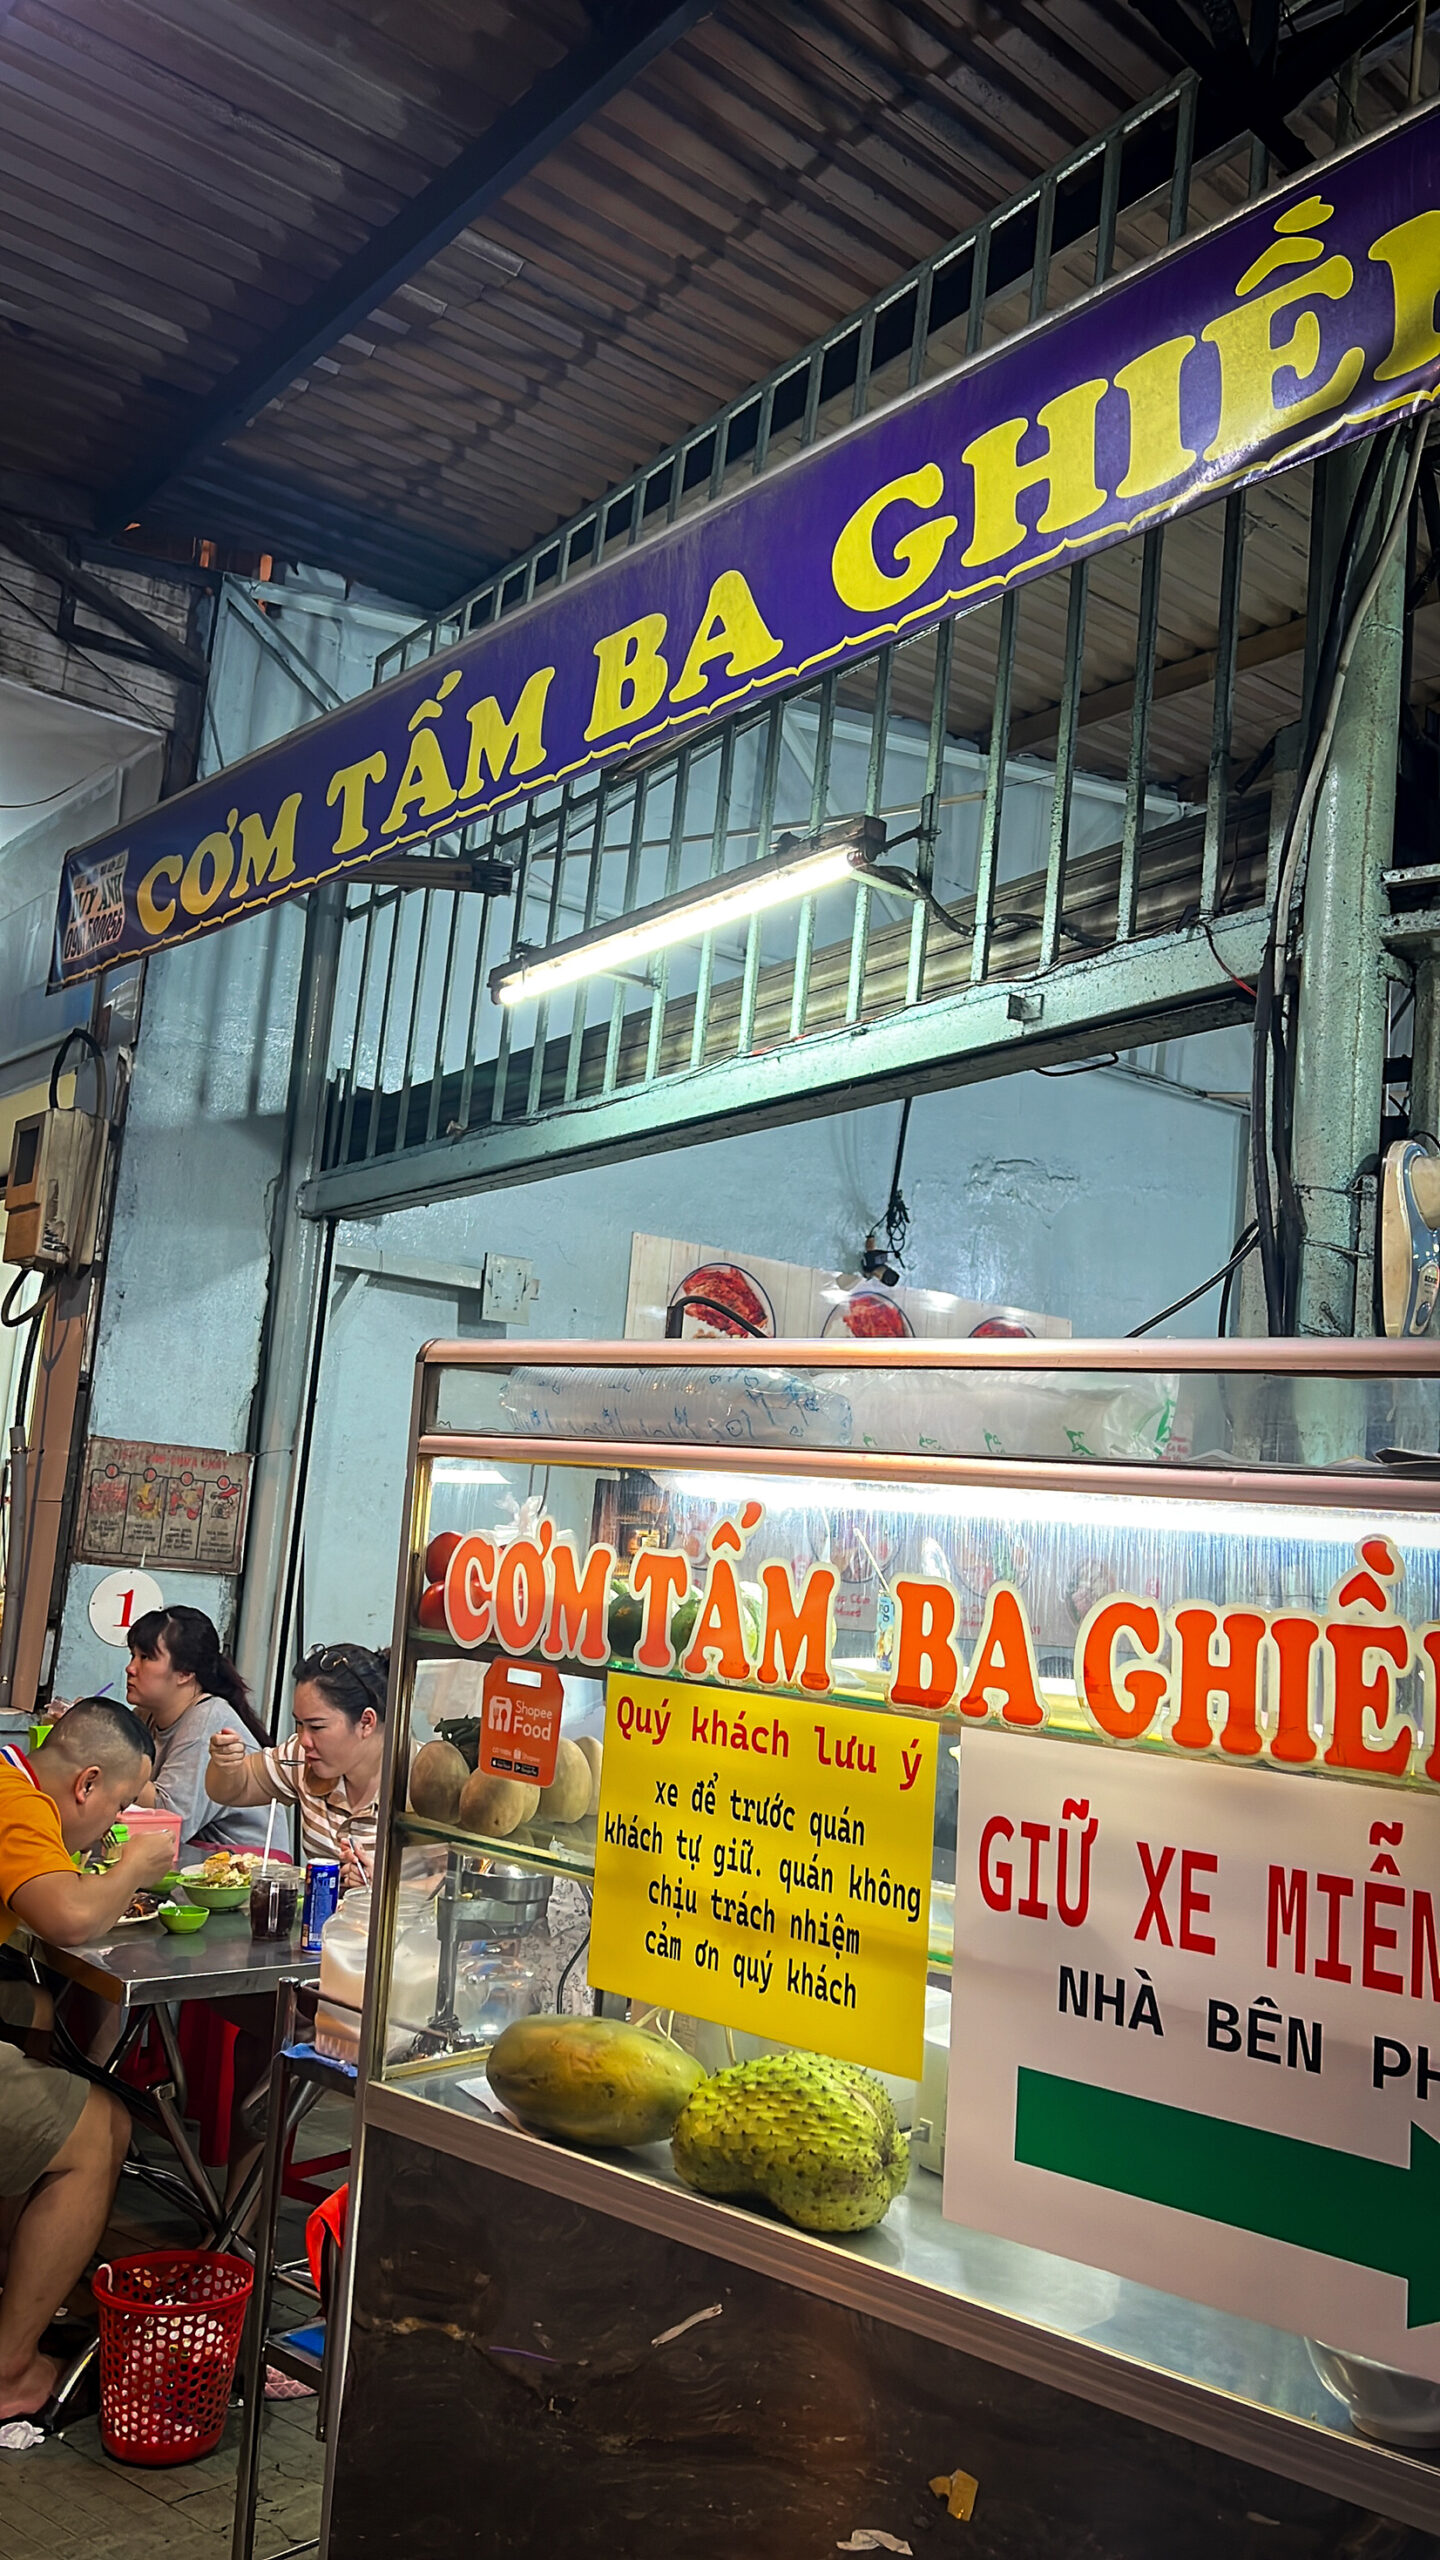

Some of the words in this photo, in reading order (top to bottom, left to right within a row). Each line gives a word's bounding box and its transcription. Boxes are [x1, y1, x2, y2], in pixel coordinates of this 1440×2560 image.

[137, 793, 302, 935] CƠM
[326, 667, 555, 854] TẤM
[584, 570, 784, 741] BA
[114, 1588, 135, 1628] 1
[446, 1517, 615, 1664] CƠM
[630, 1499, 840, 1696] TẤM
[886, 1572, 1049, 1729] BA
[513, 1716, 552, 1741] Food
[515, 1700, 553, 1721] Shopee
[616, 1697, 671, 1746] Quý
[690, 1706, 790, 1759] khách
[814, 1726, 877, 1775] lưu
[899, 1738, 923, 1792] ý
[654, 1779, 678, 1808] xe
[691, 1772, 719, 1815] để
[730, 1788, 796, 1833] trước
[809, 1807, 865, 1852] quán
[604, 1812, 663, 1855] khách
[676, 1828, 702, 1871] tự
[713, 1838, 762, 1878] giữ.
[779, 1853, 834, 1895] quán
[849, 1864, 922, 1923] không
[979, 1798, 1099, 1928] GIỮ
[1133, 1841, 1218, 1956] XE
[648, 1874, 698, 1919] chịu
[710, 1888, 776, 1934] trách
[790, 1908, 861, 1960] nhiệm
[645, 1921, 682, 1962] cảm
[694, 1940, 720, 1972] ơn
[732, 1950, 774, 1994] quý
[787, 1958, 858, 2010] khách
[1058, 1965, 1165, 2037] NHÀ
[1207, 1996, 1323, 2075] BÊN
